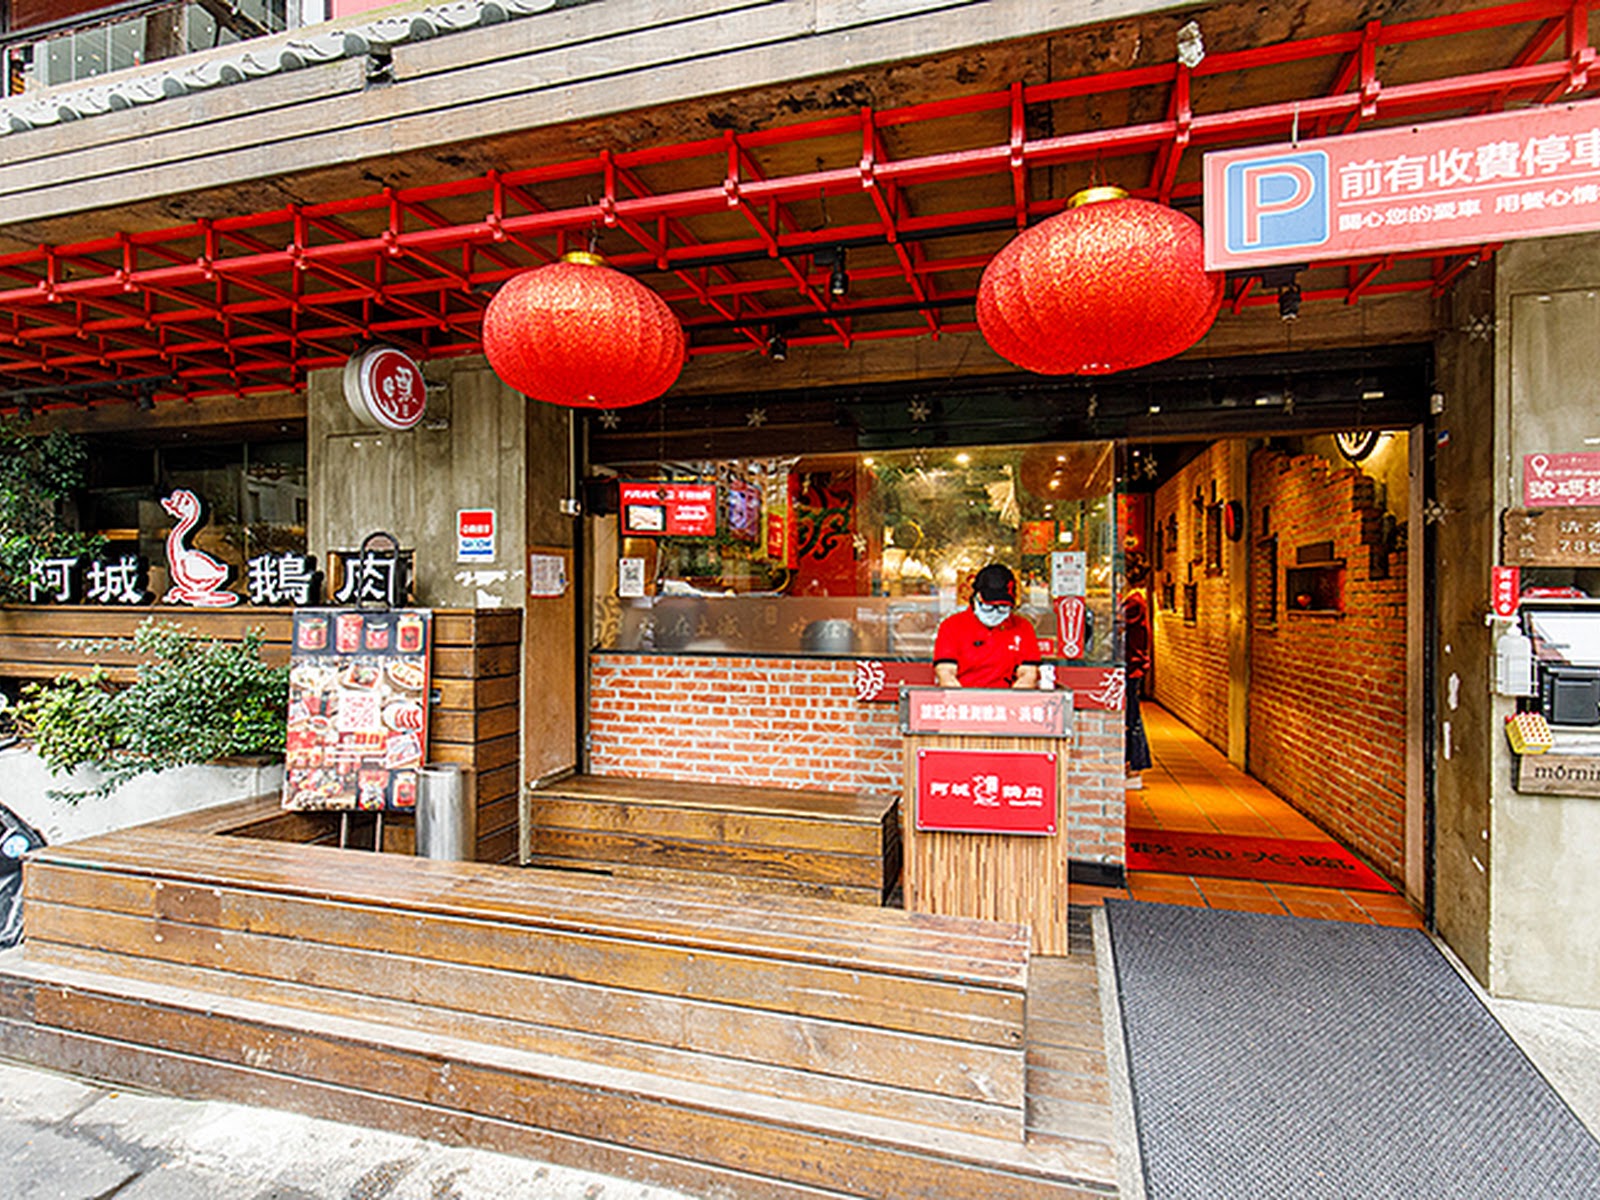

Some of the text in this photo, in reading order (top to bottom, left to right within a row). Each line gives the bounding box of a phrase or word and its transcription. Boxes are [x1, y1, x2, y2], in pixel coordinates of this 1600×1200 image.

[1338, 128, 1600, 199] 前有收費停車
[1242, 162, 1316, 247] P
[1495, 184, 1600, 215] 用餐心情
[248, 554, 395, 604] 鵝肉
